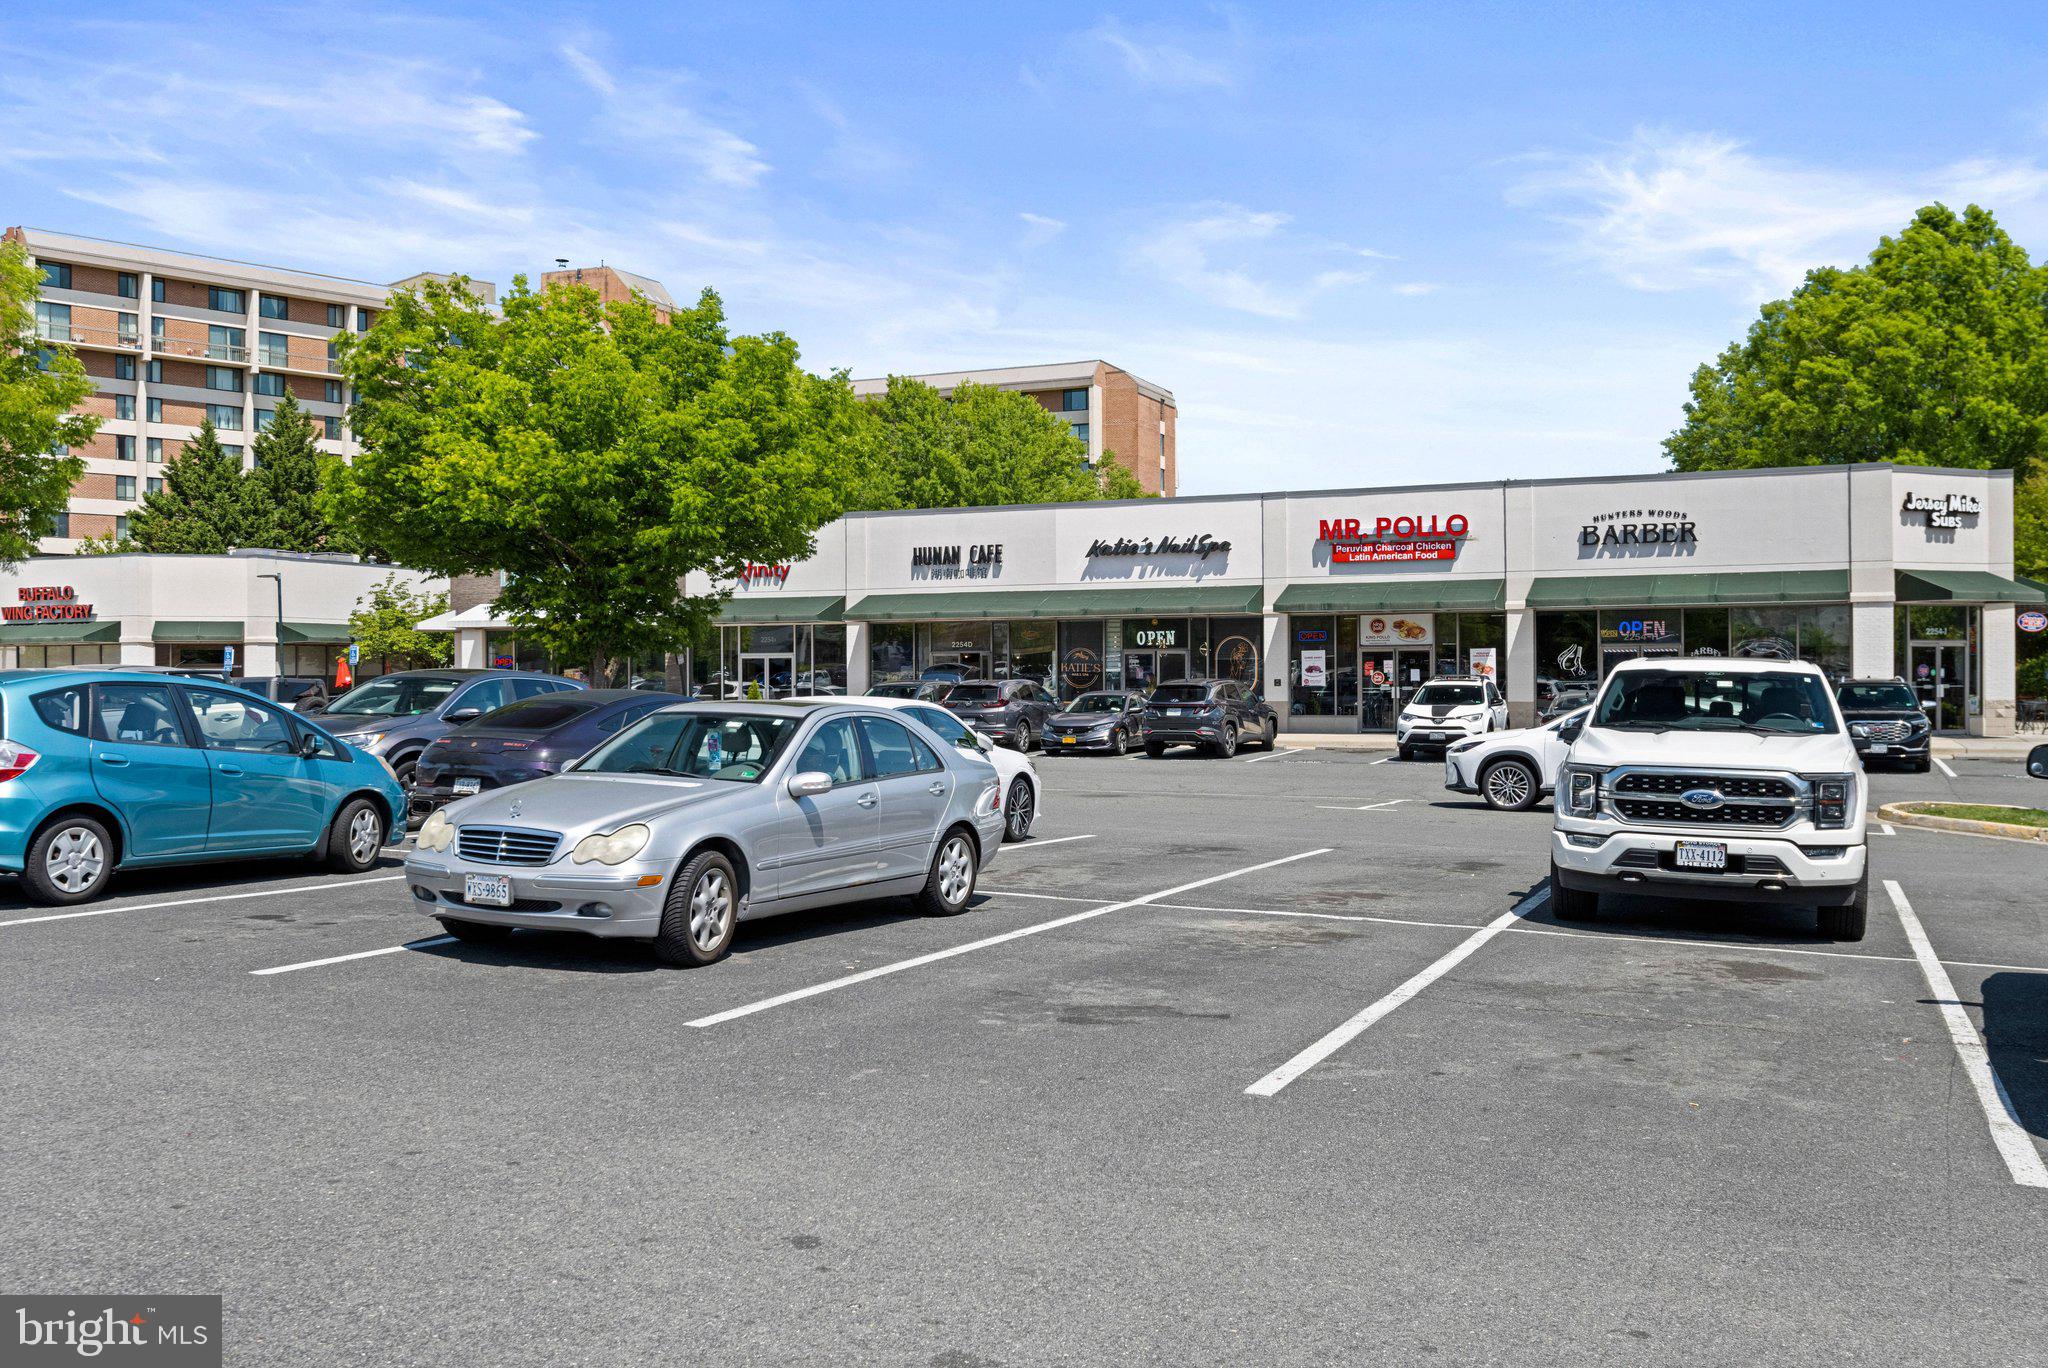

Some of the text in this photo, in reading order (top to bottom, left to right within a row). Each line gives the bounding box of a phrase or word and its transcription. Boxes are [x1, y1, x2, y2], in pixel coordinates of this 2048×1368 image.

[1905, 493, 1948, 515] Jersey
[1592, 509, 1688, 523] HUNTERS WOODS
[1319, 514, 1468, 540] MR. POLLO
[1582, 522, 1698, 545] BARBER
[913, 544, 1003, 565] HUNAN CAFE
[1085, 534, 1232, 560] Katie's Nail Spa
[1336, 542, 1452, 552] Peruvian Charcoal Chicken
[1349, 551, 1438, 561] Latin American Food
[18, 585, 75, 601] BUFFALO
[1, 604, 94, 621] WING FACTORY
[1300, 631, 1325, 639] OPEN
[1619, 620, 1665, 637] OPEN
[1136, 630, 1175, 646] OPEN
[1061, 662, 1101, 672] KATIE'S
[1692, 794, 1713, 804] Ford
[1679, 847, 1724, 862] TXX-4112
